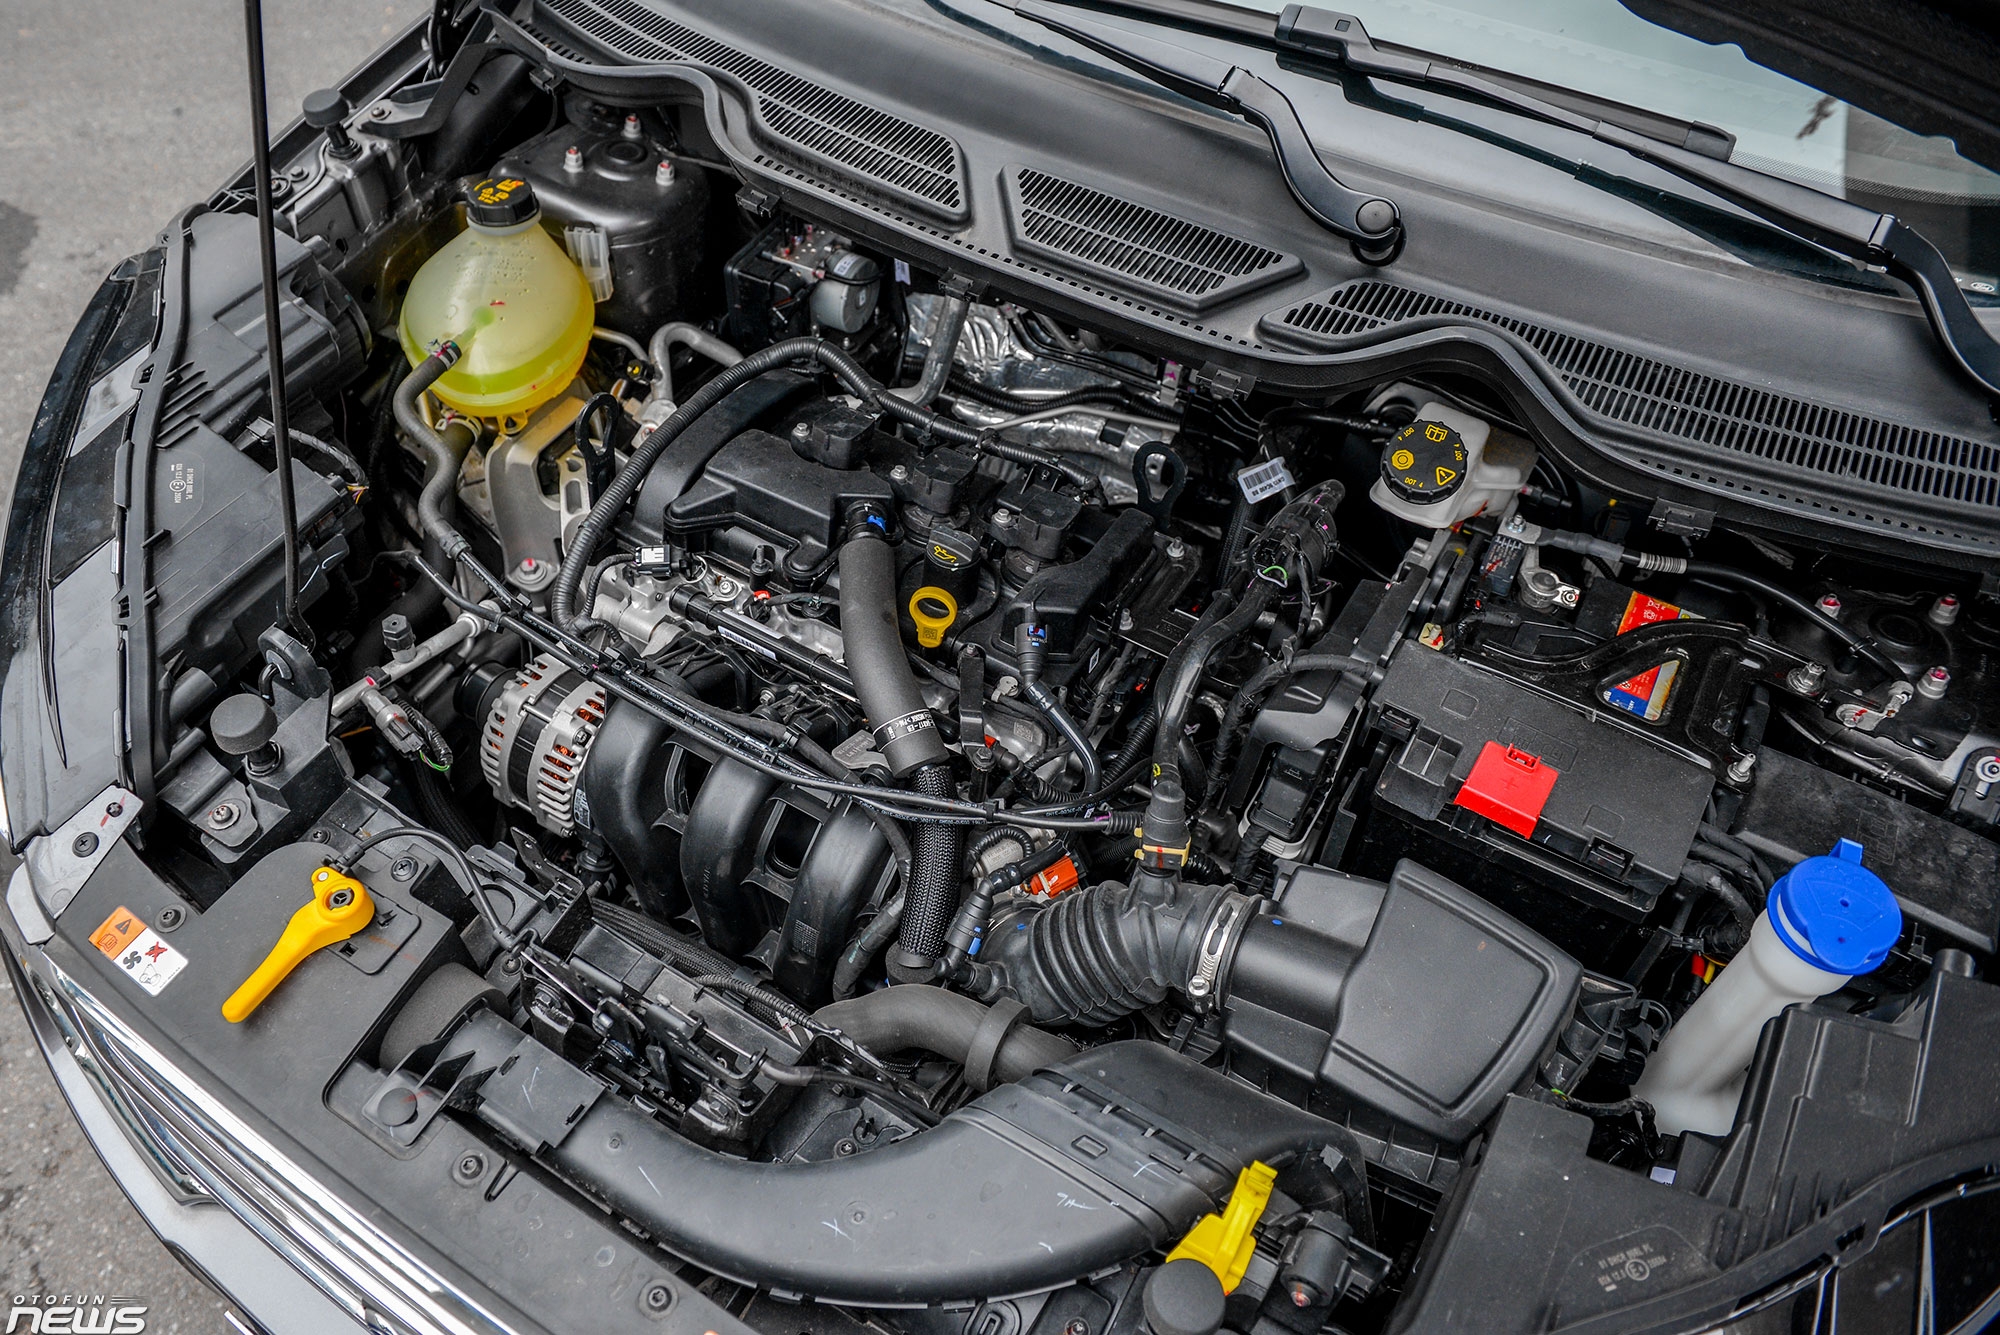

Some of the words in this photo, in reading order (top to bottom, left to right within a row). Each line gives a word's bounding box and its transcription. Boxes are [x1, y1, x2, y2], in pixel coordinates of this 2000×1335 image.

[1403, 427, 1415, 437] DOT
[1454, 450, 1463, 461] DOT
[1404, 477, 1417, 486] DOT
